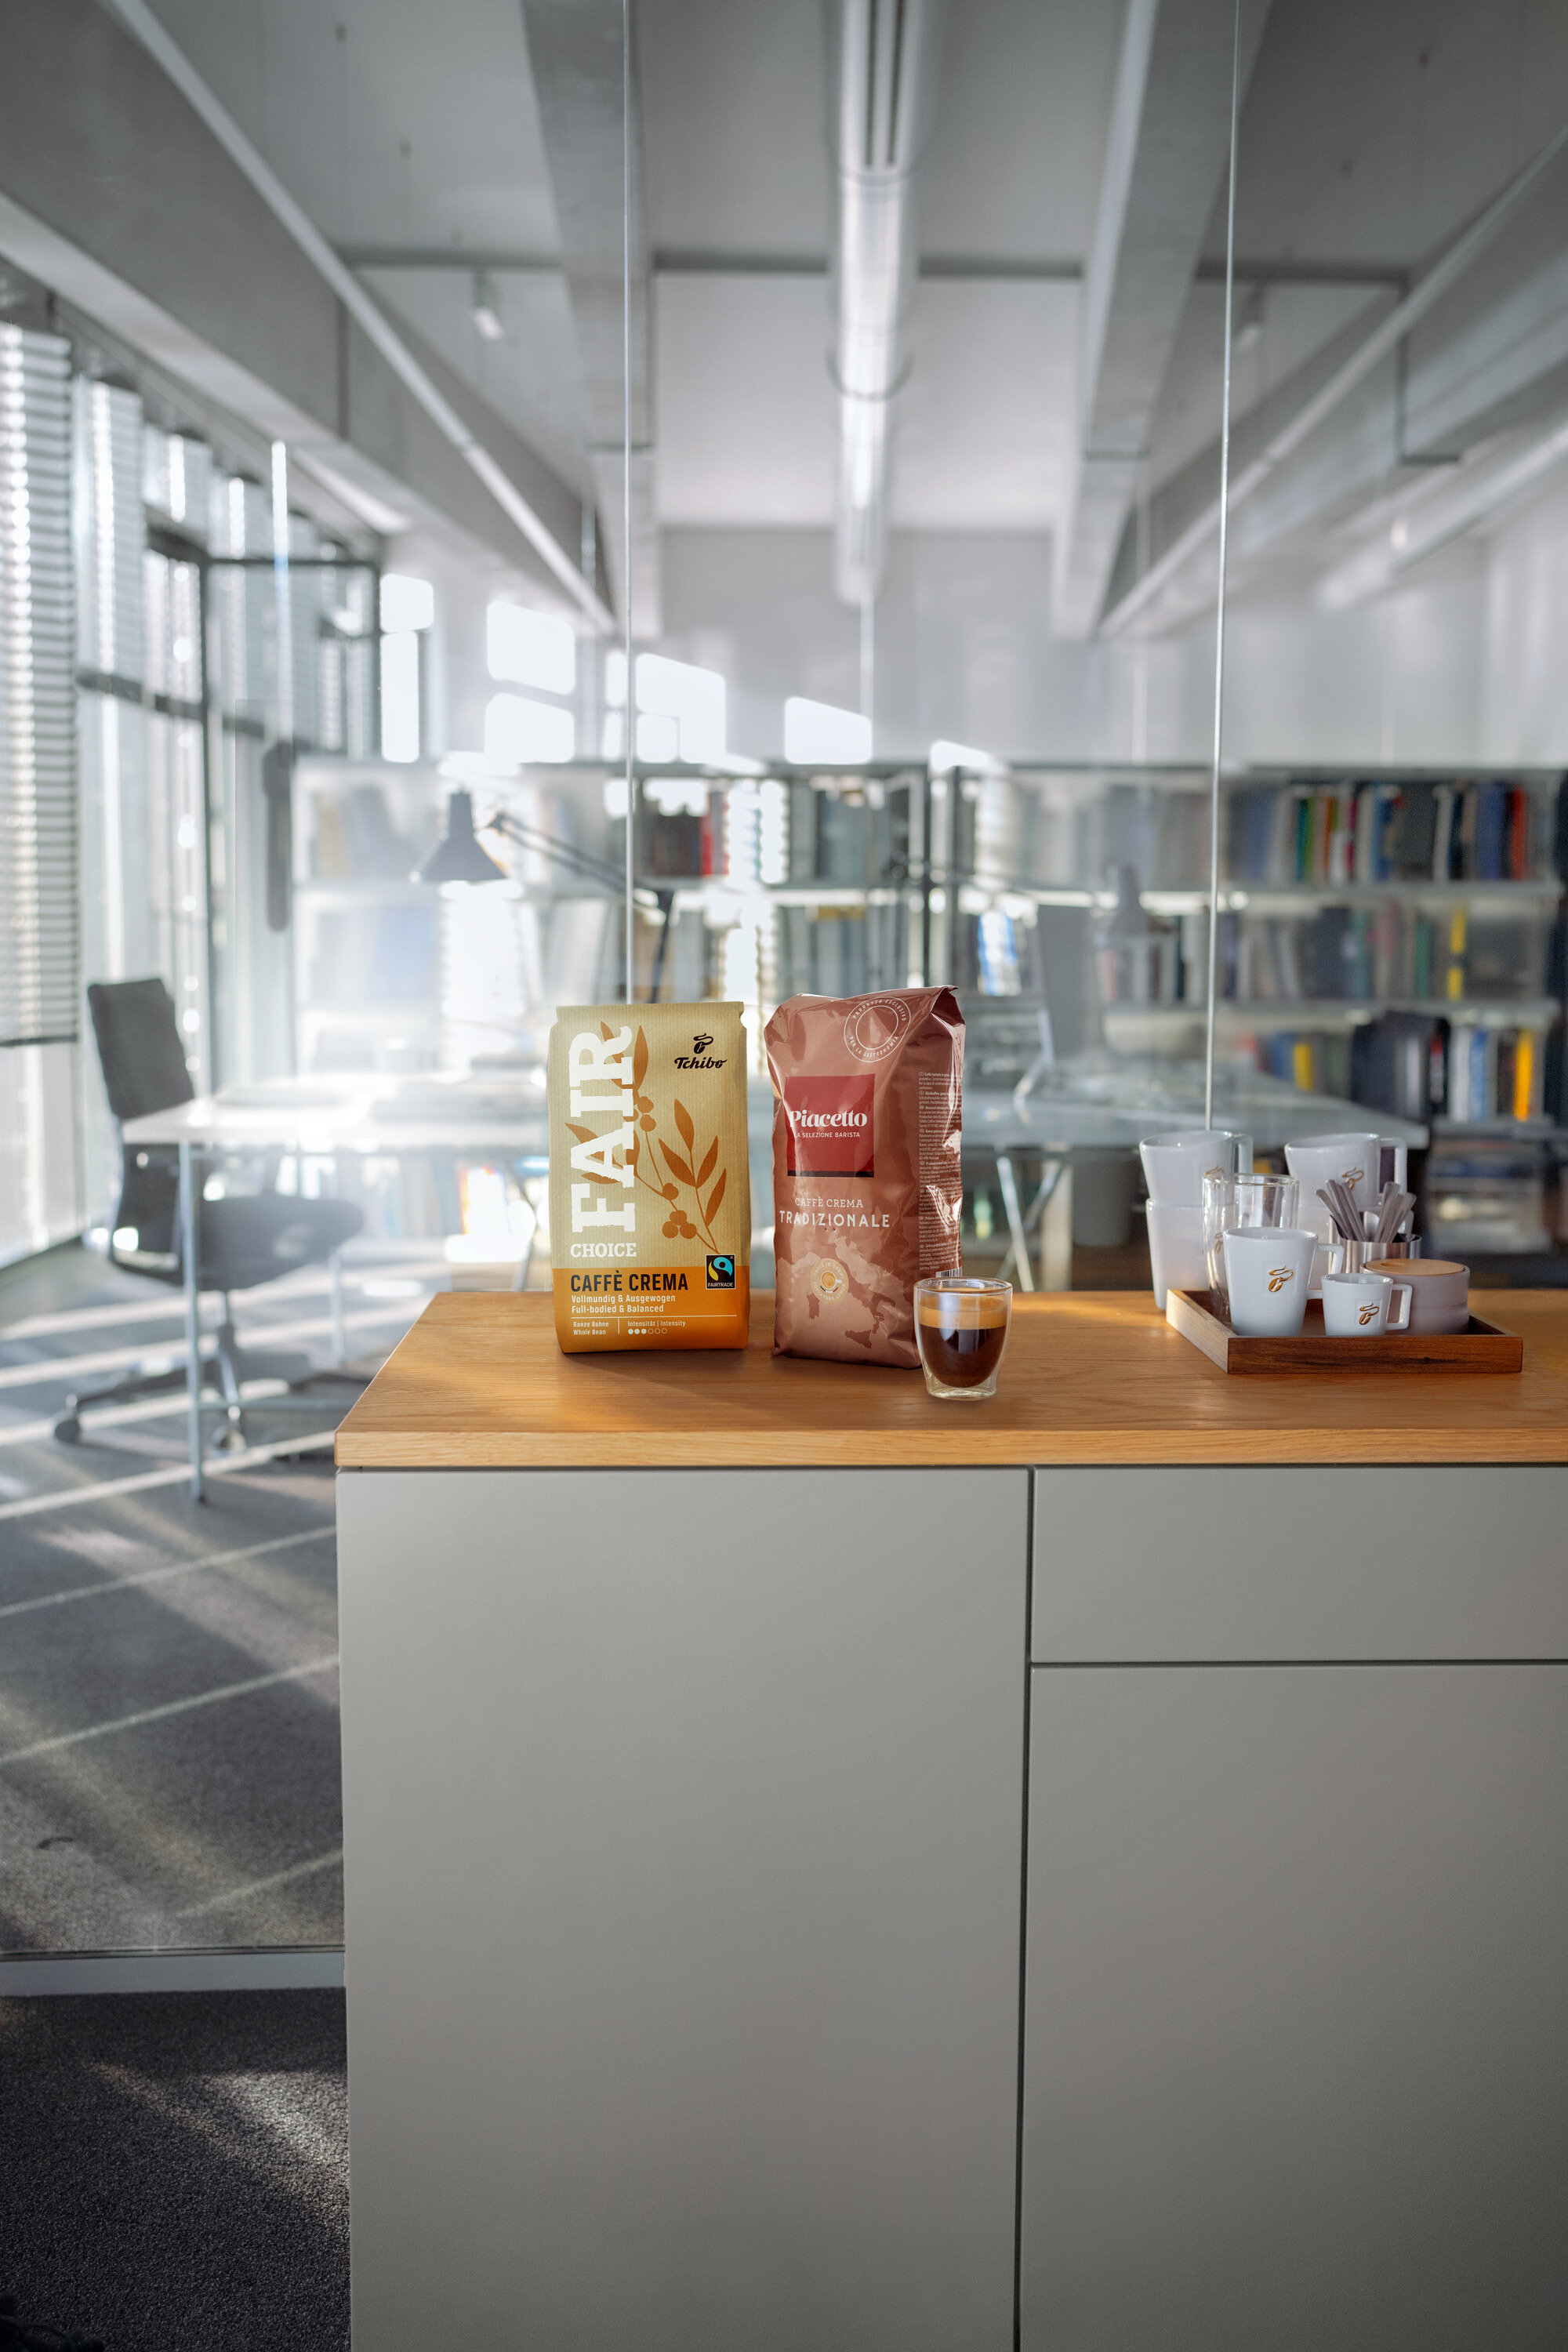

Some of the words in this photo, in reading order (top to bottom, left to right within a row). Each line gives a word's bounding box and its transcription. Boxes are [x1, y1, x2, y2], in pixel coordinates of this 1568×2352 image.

[853, 1000, 883, 1019] PRODOTTO
[885, 1000, 907, 1022] ESCLUSIVO
[863, 1036, 899, 1058] GASTRONOMIA
[673, 1057, 728, 1069] Tchibo
[789, 1109, 868, 1127] Piacetto
[568, 1025, 636, 1233] FAIR
[795, 1196, 823, 1207] CAFFÈ
[826, 1199, 864, 1208] CREMA
[779, 1210, 890, 1228] TRADIZIONALE
[570, 1243, 637, 1258] CHOICE
[570, 1269, 623, 1292] CAFFÈ
[629, 1272, 689, 1291] CREMA
[571, 1294, 616, 1305] Vollmundig
[626, 1294, 676, 1304] Ausgewogen
